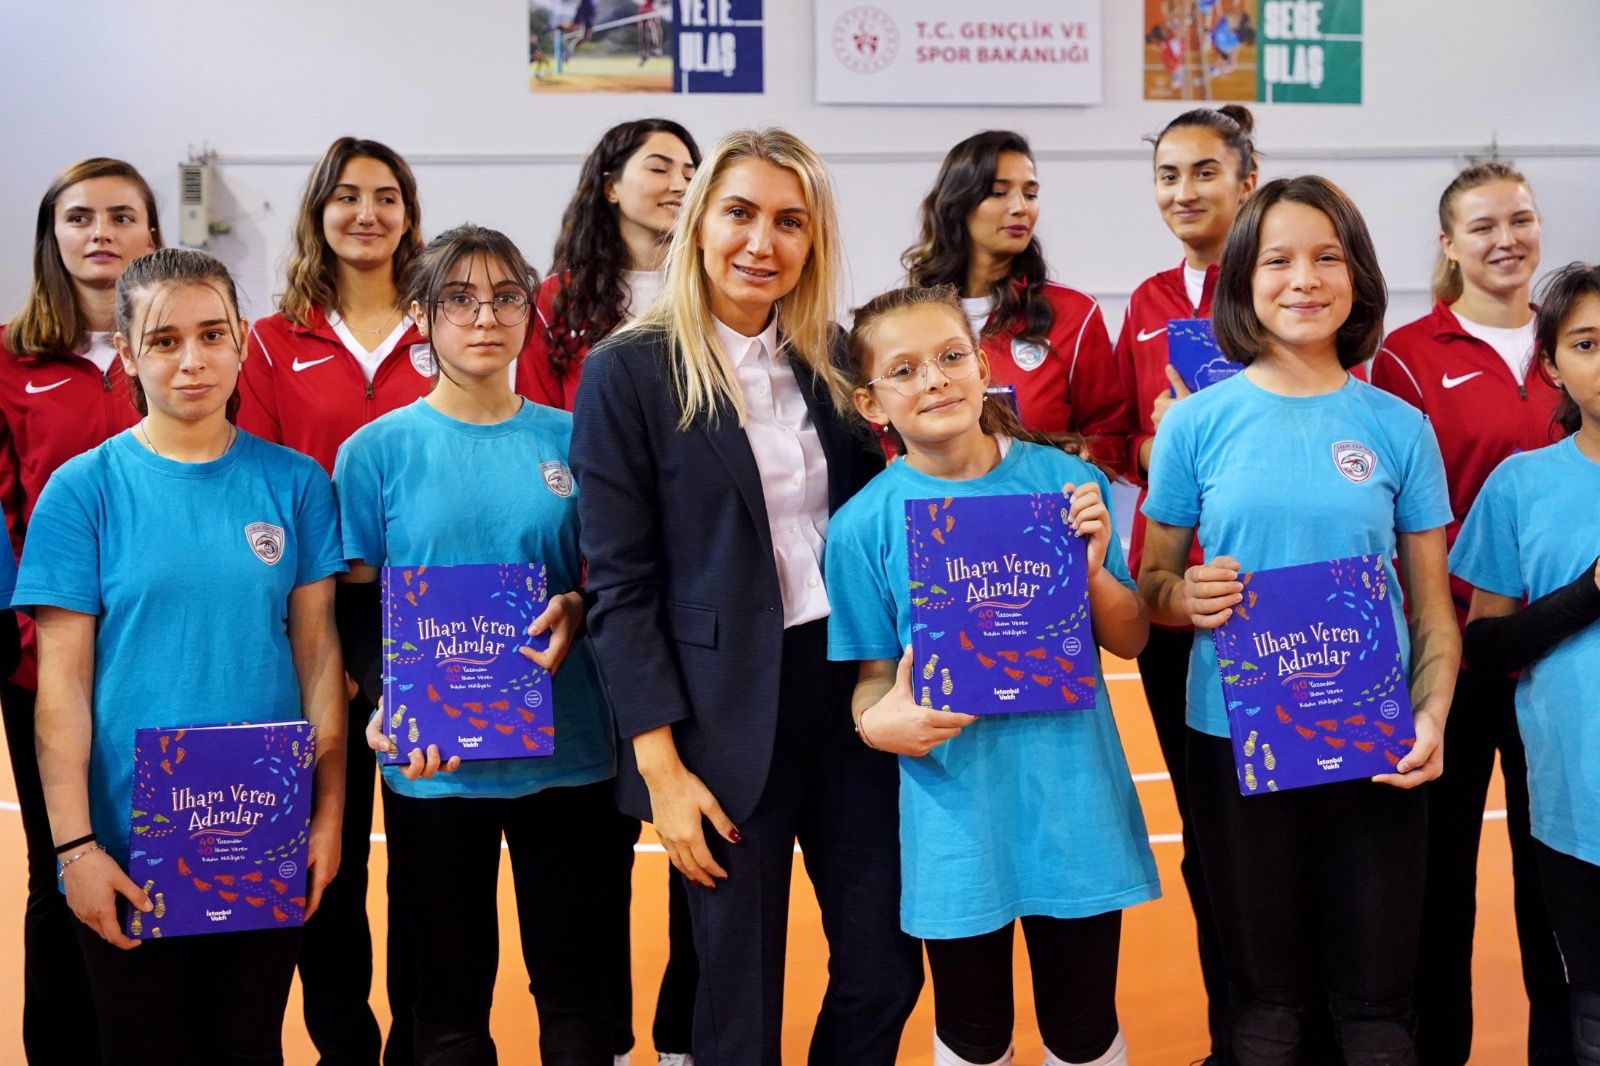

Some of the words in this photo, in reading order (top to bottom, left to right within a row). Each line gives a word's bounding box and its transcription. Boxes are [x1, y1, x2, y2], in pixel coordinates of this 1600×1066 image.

[915, 21, 953, 40] T.C.
[960, 19, 1053, 43] GENÇLİK
[1060, 21, 1088, 40] VE
[679, 31, 737, 78] ULAŞ
[915, 46, 971, 64] SPOR
[976, 43, 1090, 64] BAKANLIĞI
[1263, 44, 1325, 89] ULAŞ
[945, 557, 999, 583] İlham
[1003, 553, 1052, 578] Veren
[965, 575, 1040, 603] Adımlar
[417, 617, 467, 640] İlham
[471, 615, 517, 637] Veren
[1253, 632, 1307, 658] İlham
[1310, 622, 1361, 643] Veren
[434, 635, 505, 659] Adımlar
[1277, 643, 1351, 676] Adımlar
[171, 787, 224, 812] İlham
[230, 783, 277, 807] Veren
[187, 803, 264, 831] Adımlar
